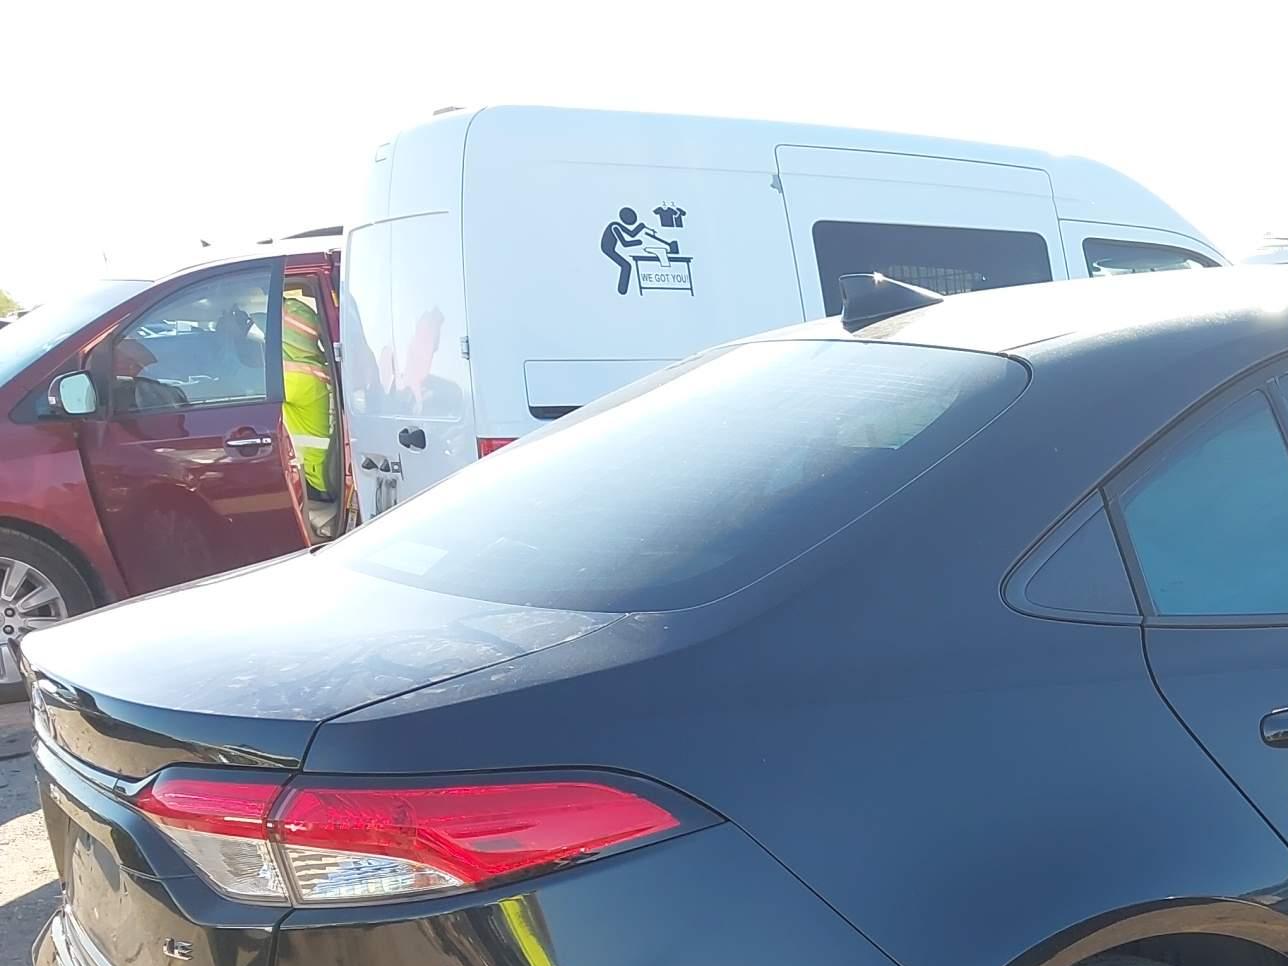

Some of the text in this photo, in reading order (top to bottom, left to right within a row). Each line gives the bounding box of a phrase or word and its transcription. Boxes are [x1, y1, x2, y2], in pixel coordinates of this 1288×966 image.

[641, 273, 689, 284] WE GOT YOU!
[162, 936, 193, 961] LE
